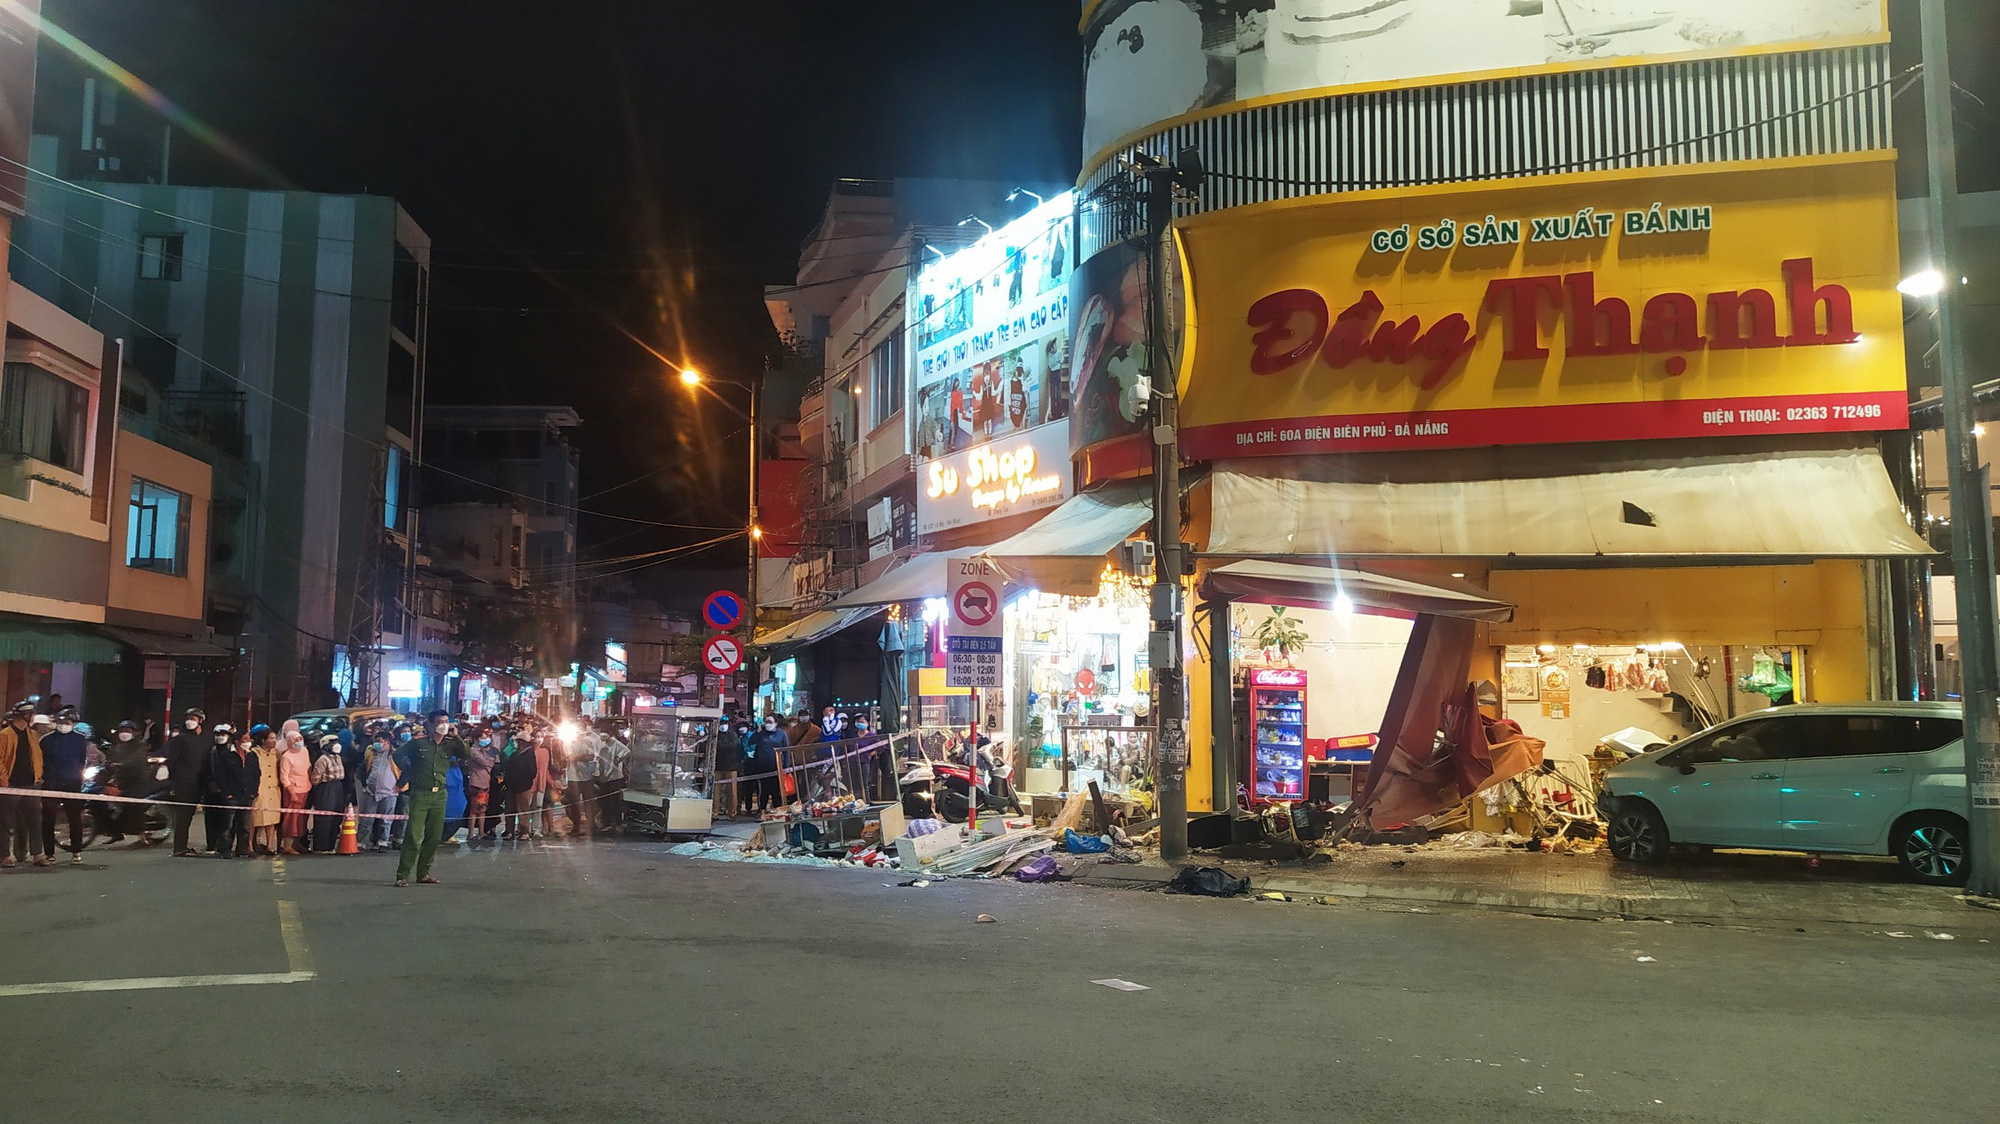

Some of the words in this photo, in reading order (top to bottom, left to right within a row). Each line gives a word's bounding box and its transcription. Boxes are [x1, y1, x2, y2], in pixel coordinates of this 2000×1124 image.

[1371, 225, 1409, 253] CƠ
[1418, 219, 1456, 250] SỞ
[1463, 215, 1520, 247] SẢN
[1531, 207, 1615, 241] XUẤT
[1625, 203, 1712, 235] BÁNH
[971, 330, 994, 355] TRANG
[1013, 315, 1026, 338] EM
[1030, 305, 1047, 330] CAO
[1050, 291, 1068, 321] CẤP
[1247, 288, 1477, 391] Đông
[1486, 257, 1862, 376] Thạnh
[1703, 408, 1735, 426] ĐIỆN
[1739, 408, 1781, 425] THOẠI:
[1787, 406, 1828, 421] 02363
[1832, 404, 1882, 419] 712496
[1236, 431, 1254, 447] ĐỊA
[1256, 427, 1277, 443] CHỈ:
[1280, 429, 1302, 442] 60A
[1304, 425, 1331, 443] ĐIỆN
[1334, 423, 1360, 439] BIÊN
[1363, 421, 1387, 438] PHỦ
[1394, 422, 1411, 437] ĐÀ
[927, 460, 959, 499] Su
[966, 445, 1036, 488] Shop
[960, 562, 990, 576] ZONE
[953, 654, 972, 663] 06:30
[976, 654, 996, 664] 08:30
[953, 665, 972, 674] 11:00
[976, 665, 996, 675] 12:00
[952, 676, 972, 685] 16:00
[976, 676, 995, 686] 19:00
